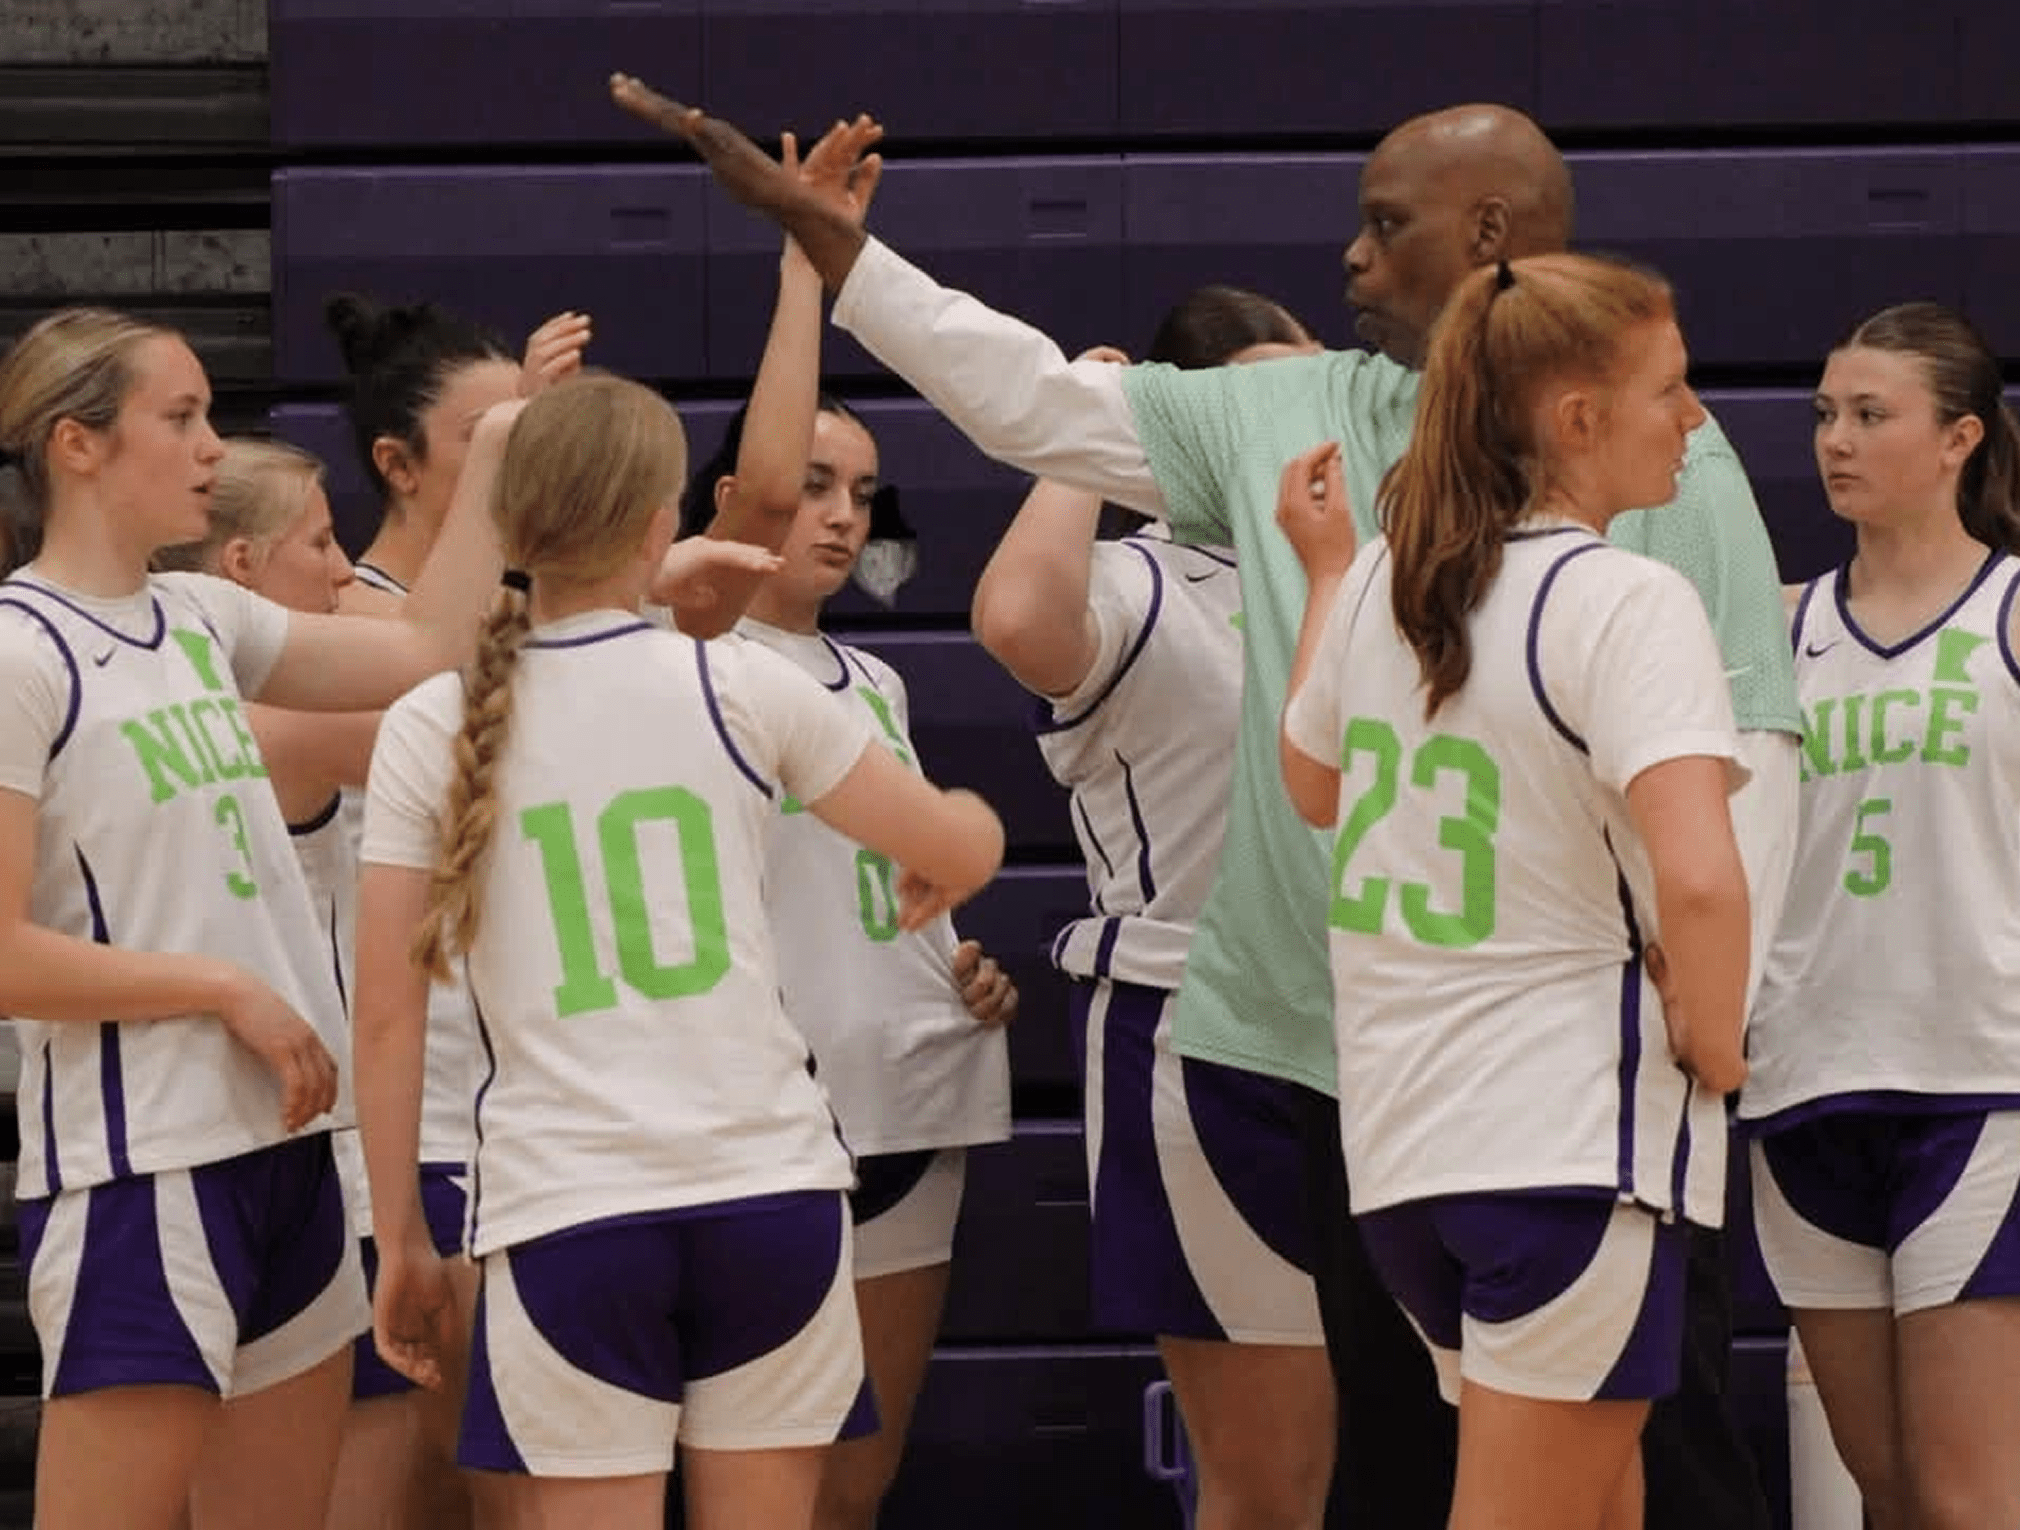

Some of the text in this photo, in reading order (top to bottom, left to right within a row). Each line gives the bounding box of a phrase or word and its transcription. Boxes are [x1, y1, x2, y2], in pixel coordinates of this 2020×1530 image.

[120, 697, 269, 804] NICE
[1800, 688, 1978, 781] NICE
[215, 795, 258, 899] 3
[1328, 717, 1500, 948] 23
[1843, 798, 1892, 897] 5
[519, 784, 731, 1019] 10
[855, 849, 899, 941] 0
